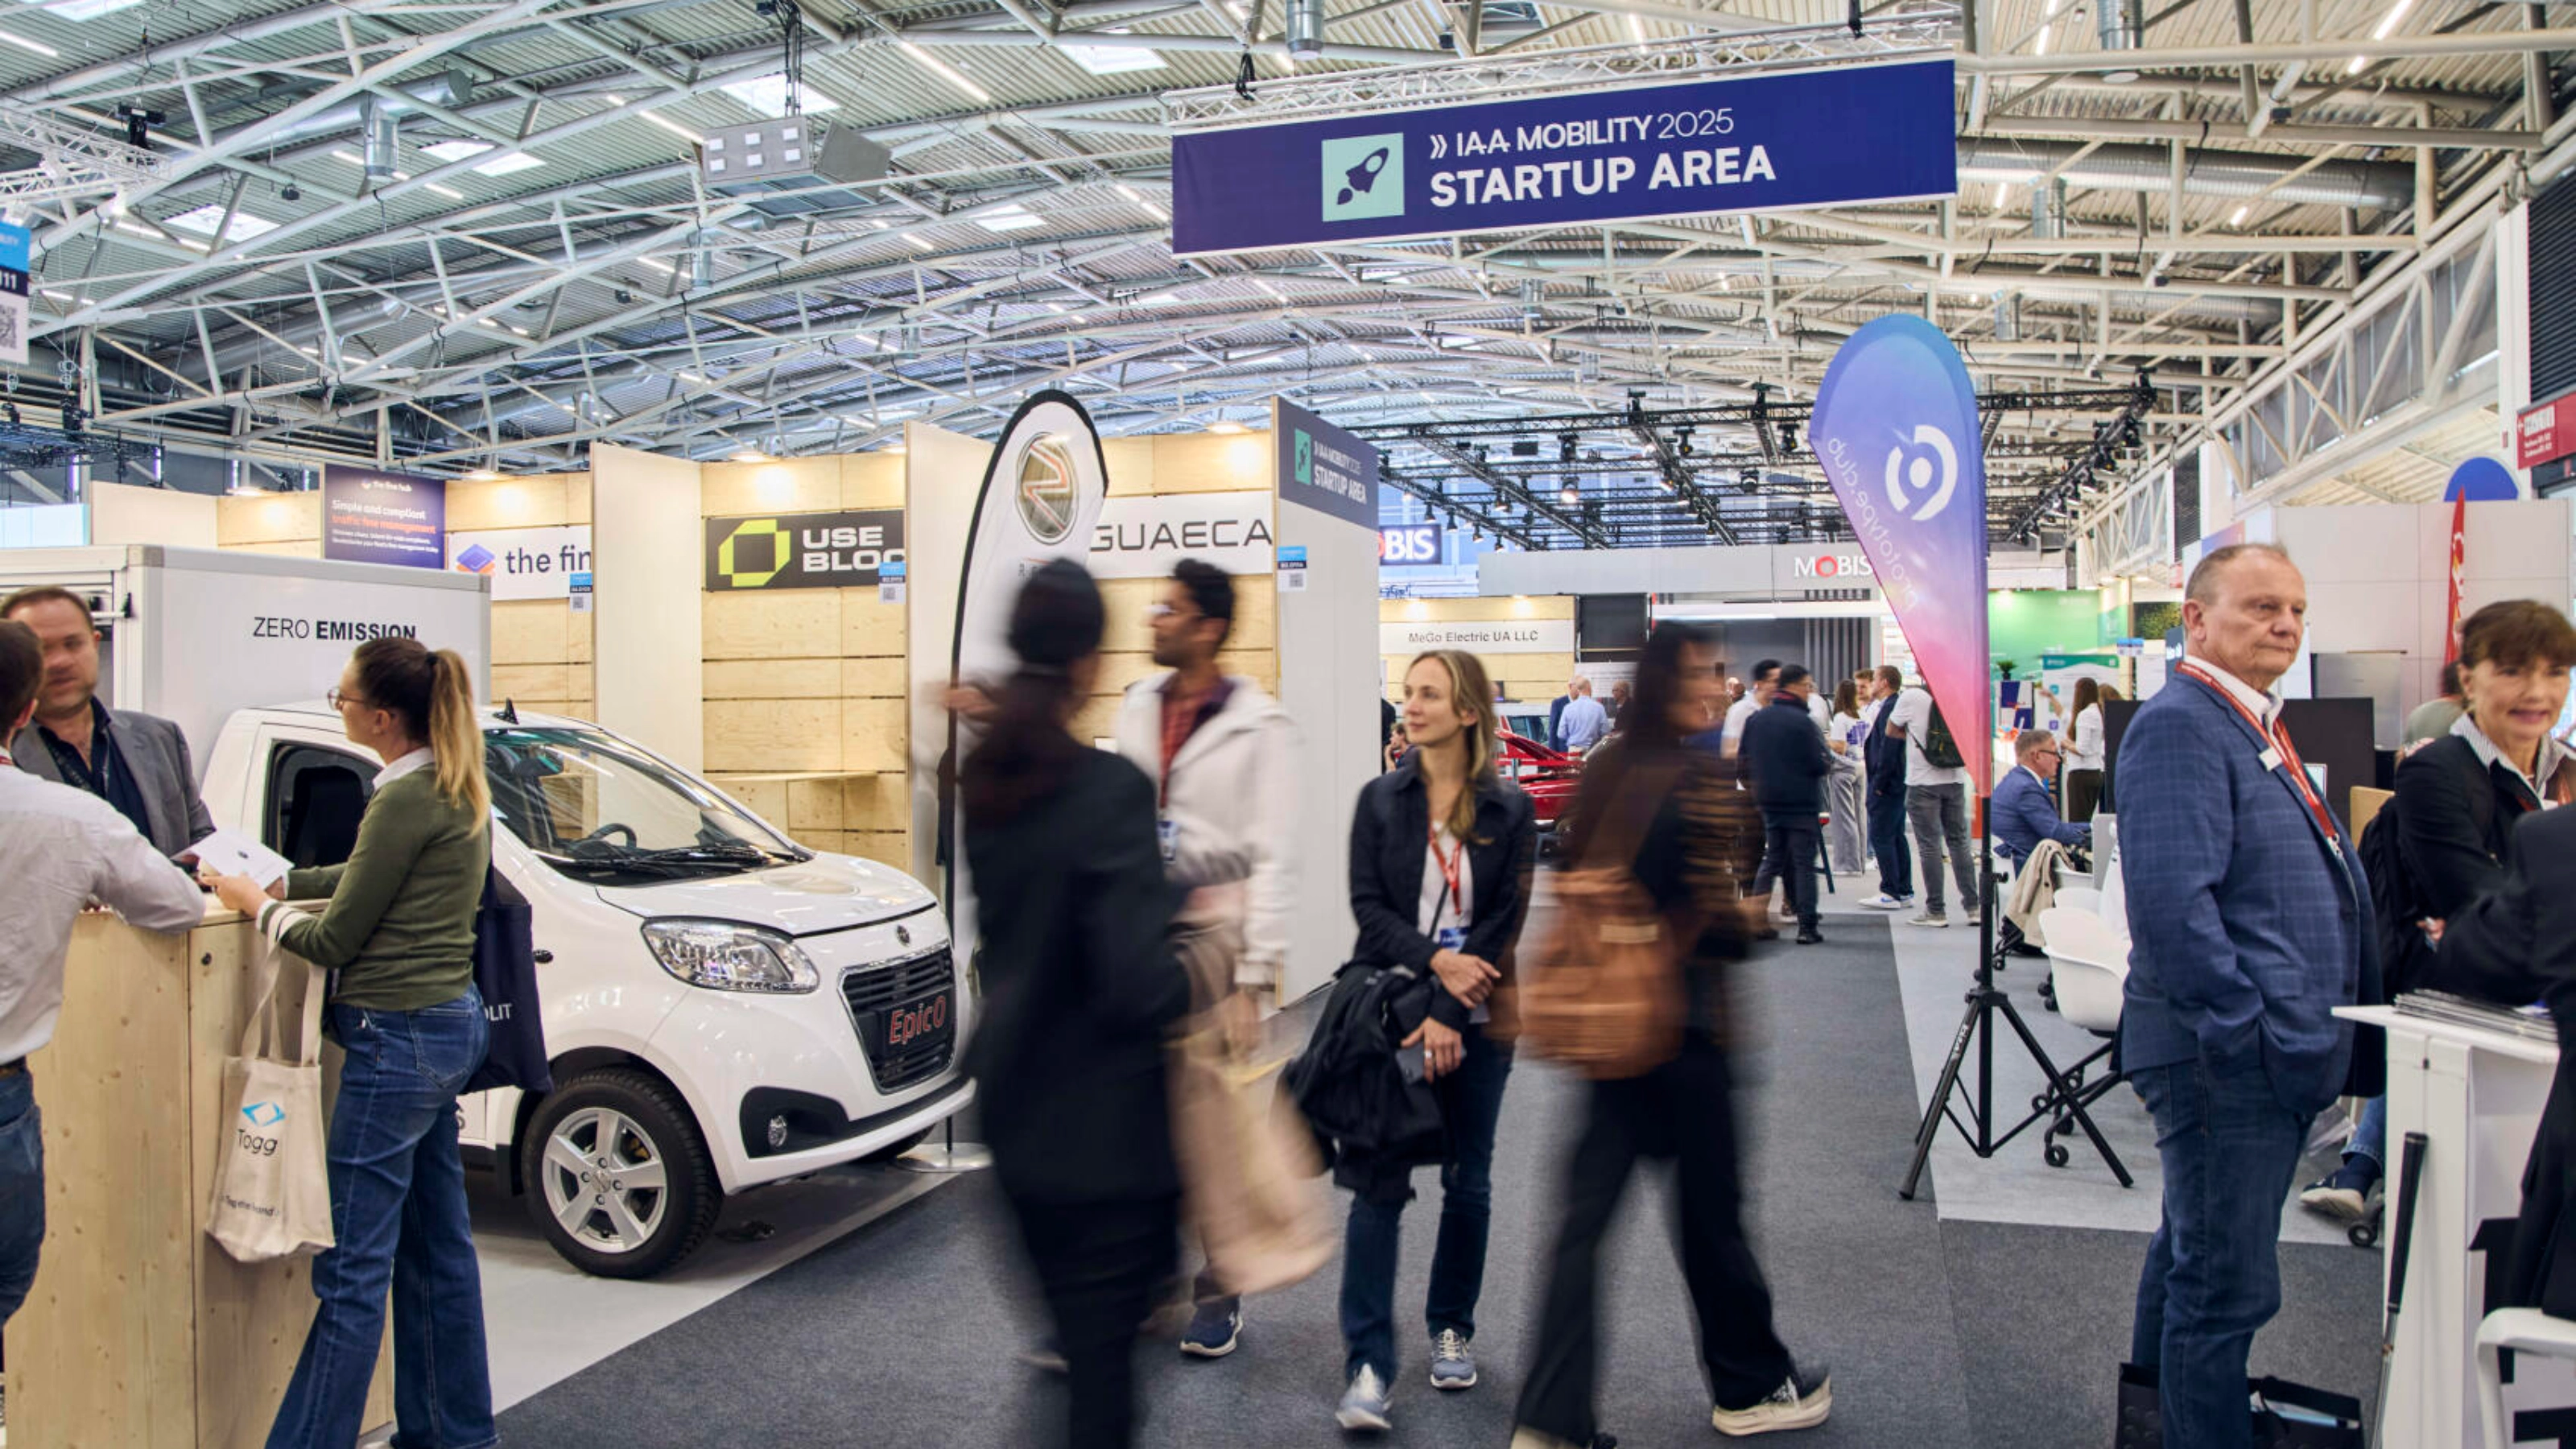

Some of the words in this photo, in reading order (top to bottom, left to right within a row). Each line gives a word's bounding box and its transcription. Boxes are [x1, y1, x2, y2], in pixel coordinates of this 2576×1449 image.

[1456, 129, 1510, 157] IAA
[1517, 115, 1653, 151] MOBILITY
[1657, 108, 1734, 139] 2025
[1430, 157, 1636, 208] STARTUP
[1648, 145, 1777, 190] AREA
[1315, 464, 1348, 495] STARTUP
[1348, 478, 1367, 504] AREA
[803, 526, 884, 549] USE
[1379, 529, 1435, 560] BIS
[506, 547, 551, 574] the
[559, 545, 591, 572] fin
[1794, 555, 1874, 578] MOBIS
[253, 617, 310, 638] ZERO
[316, 621, 416, 641] EMISSION
[1409, 633, 1442, 643] MeGo
[1447, 631, 1489, 642] Electric
[1493, 632, 1511, 642] UA
[1514, 630, 1538, 641] LLC
[485, 1003, 513, 1022] LIT
[237, 1129, 278, 1156] Togg
